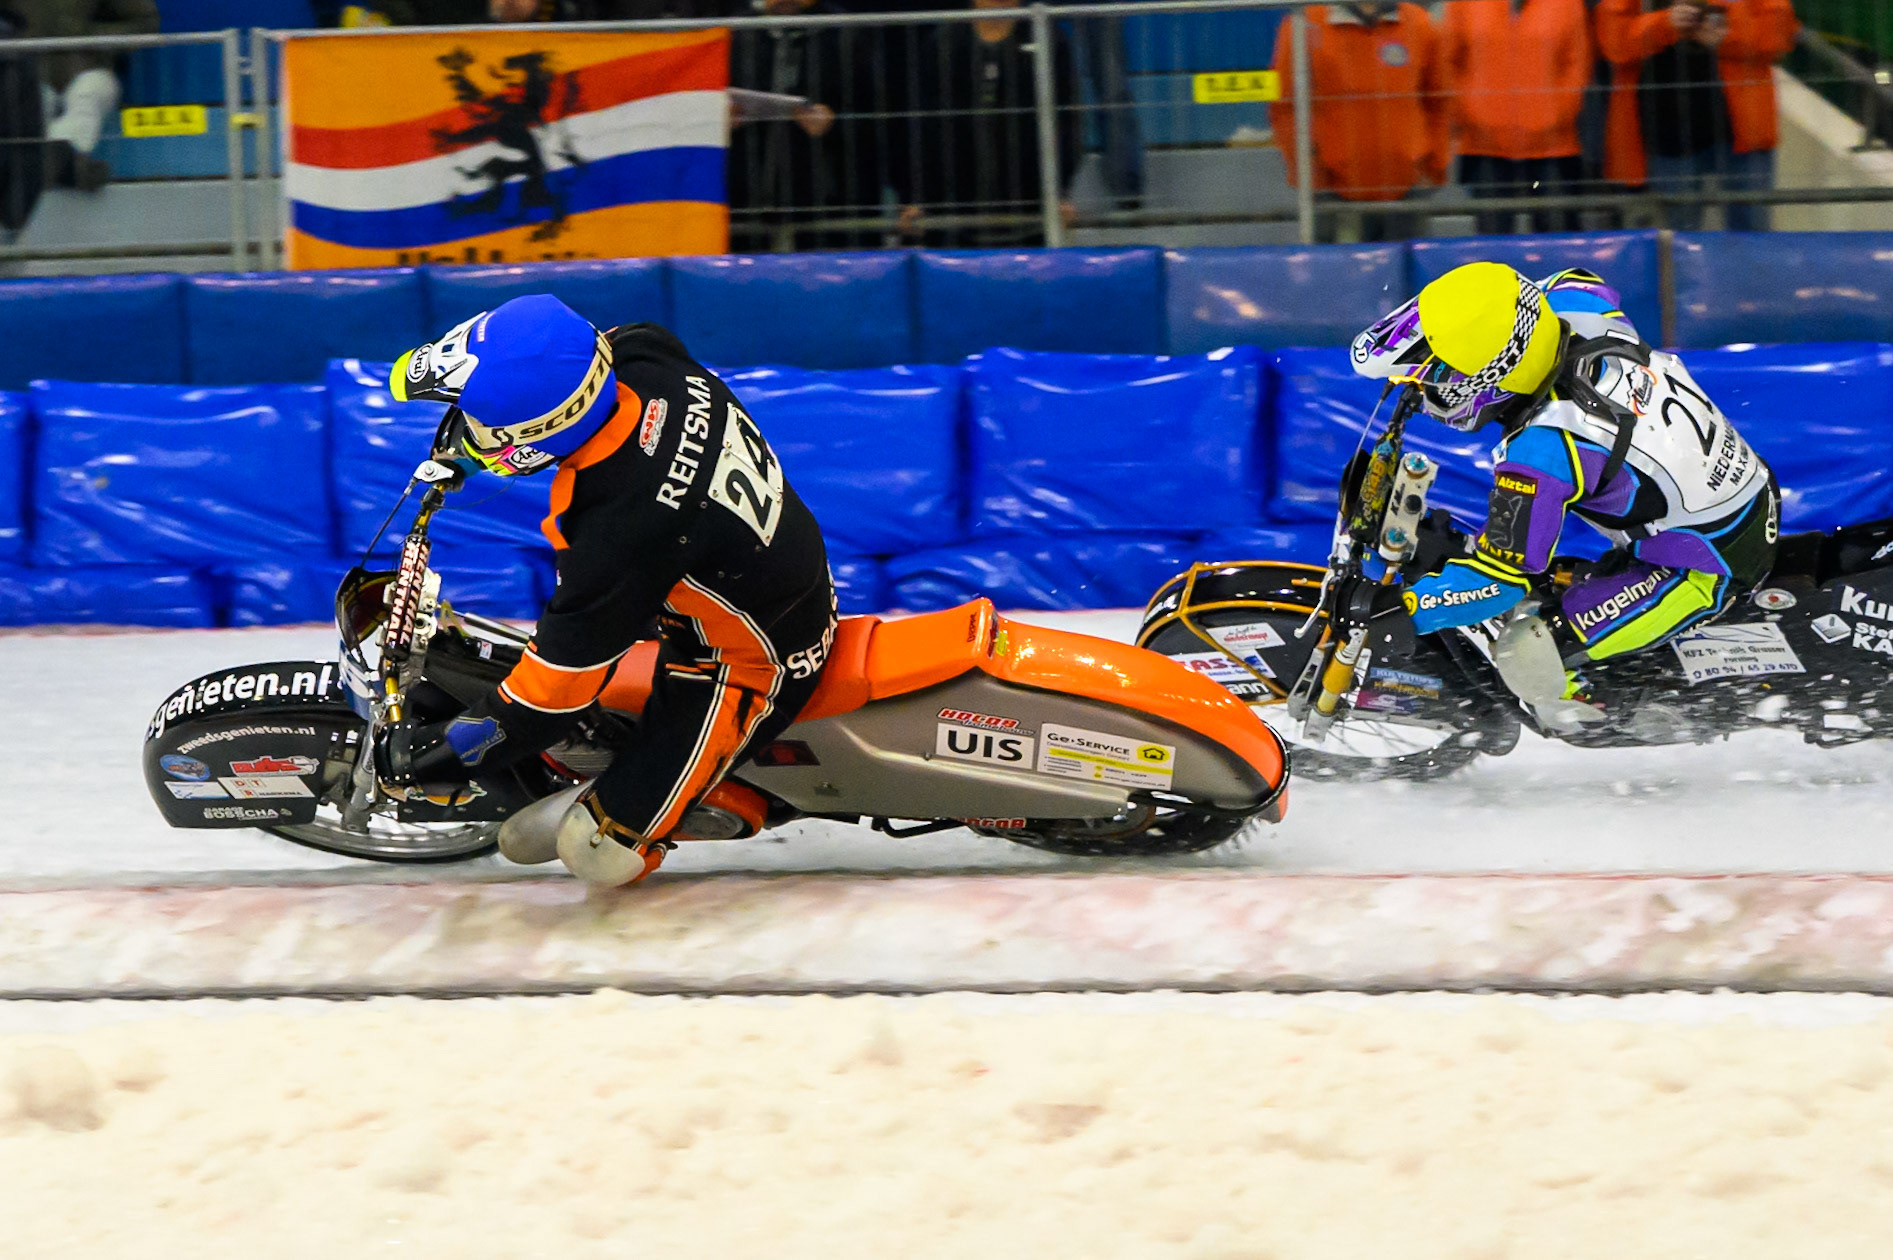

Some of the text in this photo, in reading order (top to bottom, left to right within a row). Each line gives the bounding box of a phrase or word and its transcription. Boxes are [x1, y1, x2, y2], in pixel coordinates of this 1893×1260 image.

[518, 357, 605, 440] SCOTT
[1456, 340, 1521, 395] SCOTT
[656, 375, 712, 511] REITSMA
[1661, 373, 1718, 457] 21
[725, 407, 777, 531] 24
[385, 541, 419, 645] RENTHAL
[176, 725, 316, 755] zweedsgenieten.nl
[947, 729, 1023, 762] UIS
